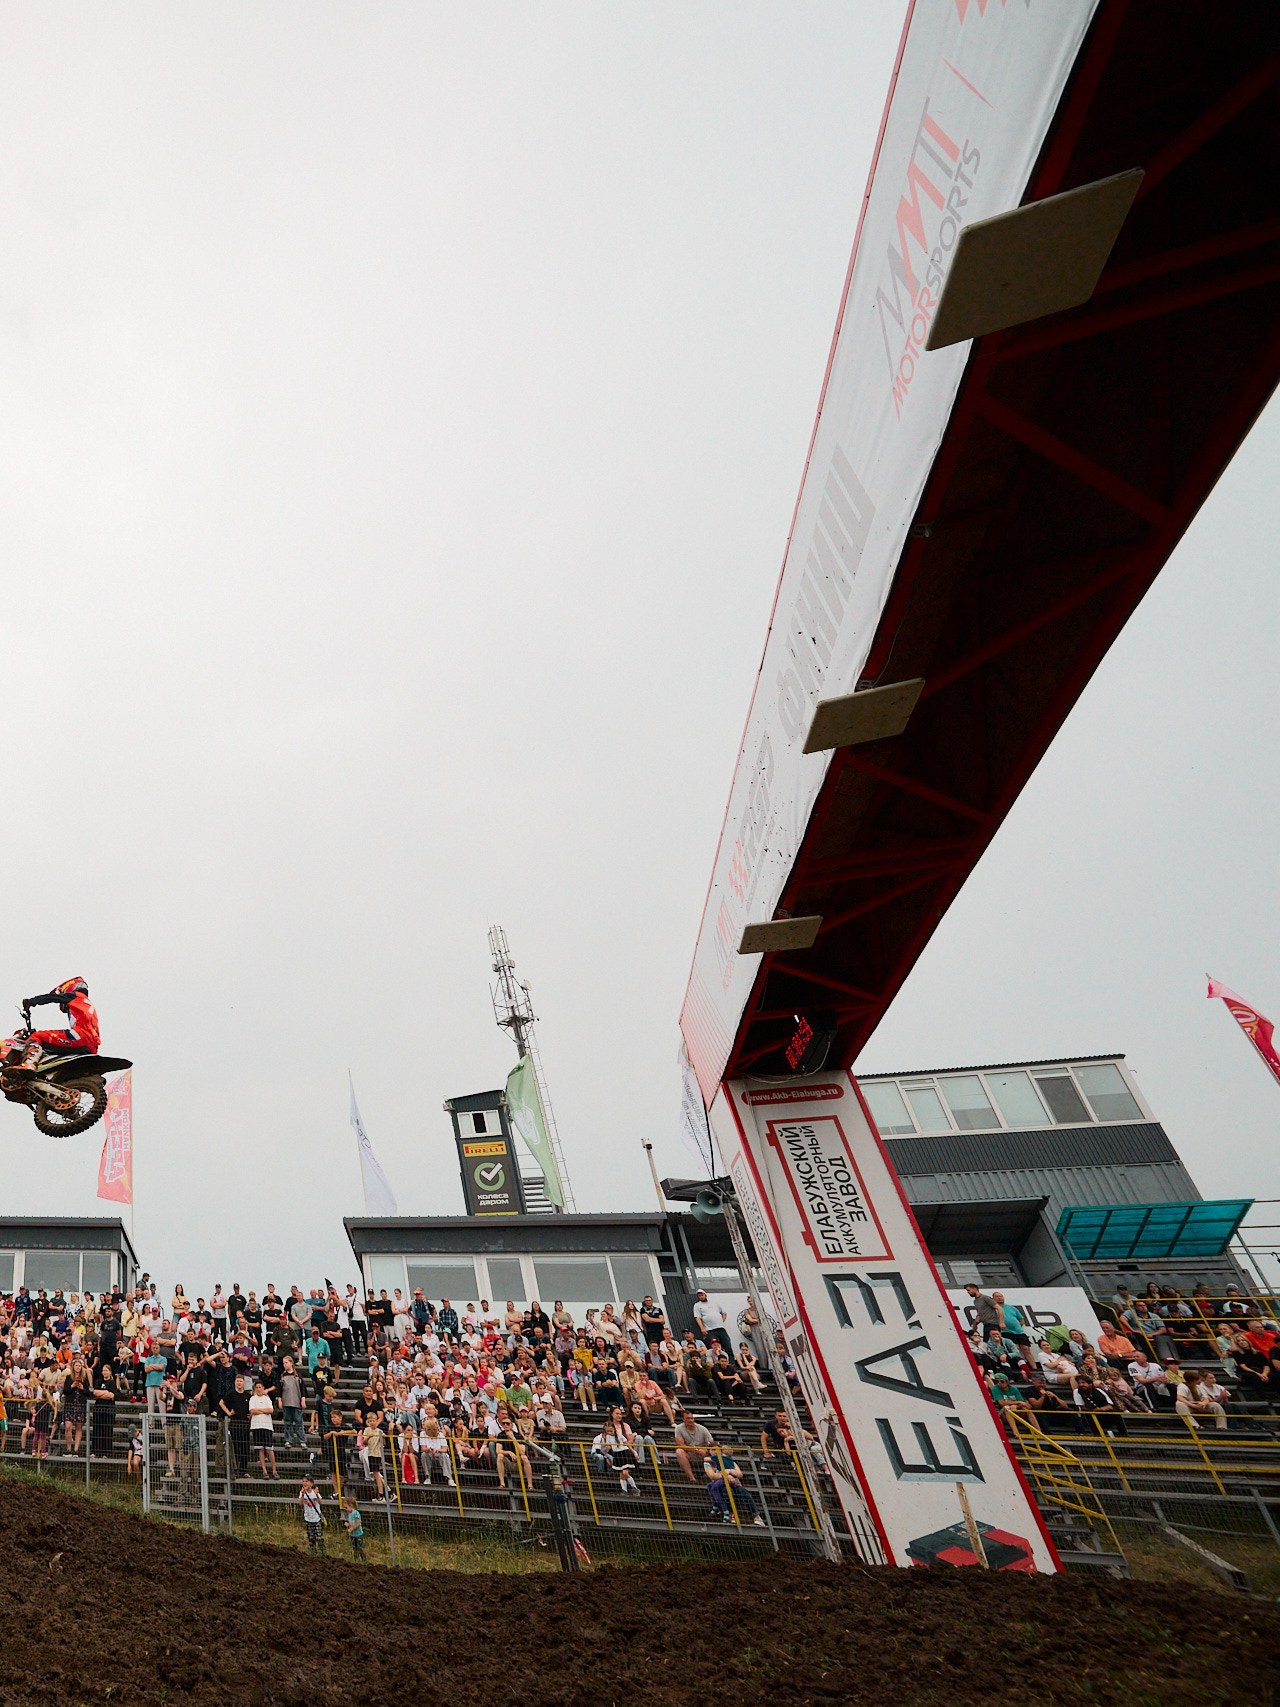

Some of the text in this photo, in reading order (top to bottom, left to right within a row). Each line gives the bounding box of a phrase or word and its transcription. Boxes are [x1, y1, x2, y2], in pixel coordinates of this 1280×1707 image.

[892, 139, 982, 422] MOTORSPORTS
[778, 444, 877, 744] ФИНИШ
[464, 1143, 504, 1154] PIRELLI
[779, 1125, 844, 1255] ЕЛАБУЖСКИЙ
[799, 1125, 862, 1256] АККУМУЛЯТОРНЫЙ
[828, 1155, 868, 1223] ЗАВОД
